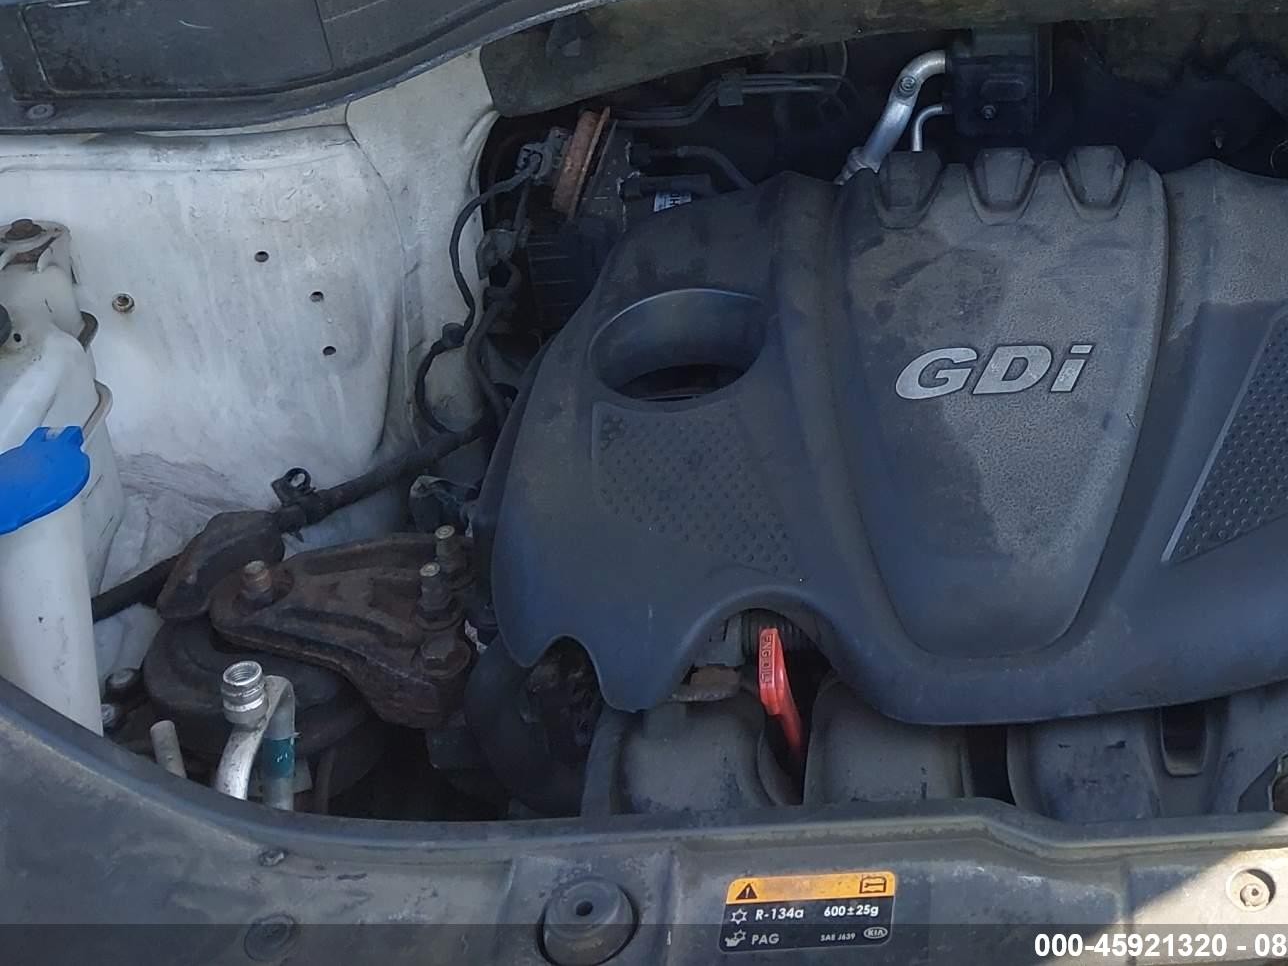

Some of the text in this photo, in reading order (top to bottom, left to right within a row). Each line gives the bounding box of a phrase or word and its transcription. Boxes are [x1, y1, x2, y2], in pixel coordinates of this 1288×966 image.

[895, 344, 1094, 400] GDi
[761, 634, 772, 657] ENG
[754, 904, 879, 921] R-134a 600±25g
[751, 933, 780, 945] PAG
[820, 933, 836, 942] SAE
